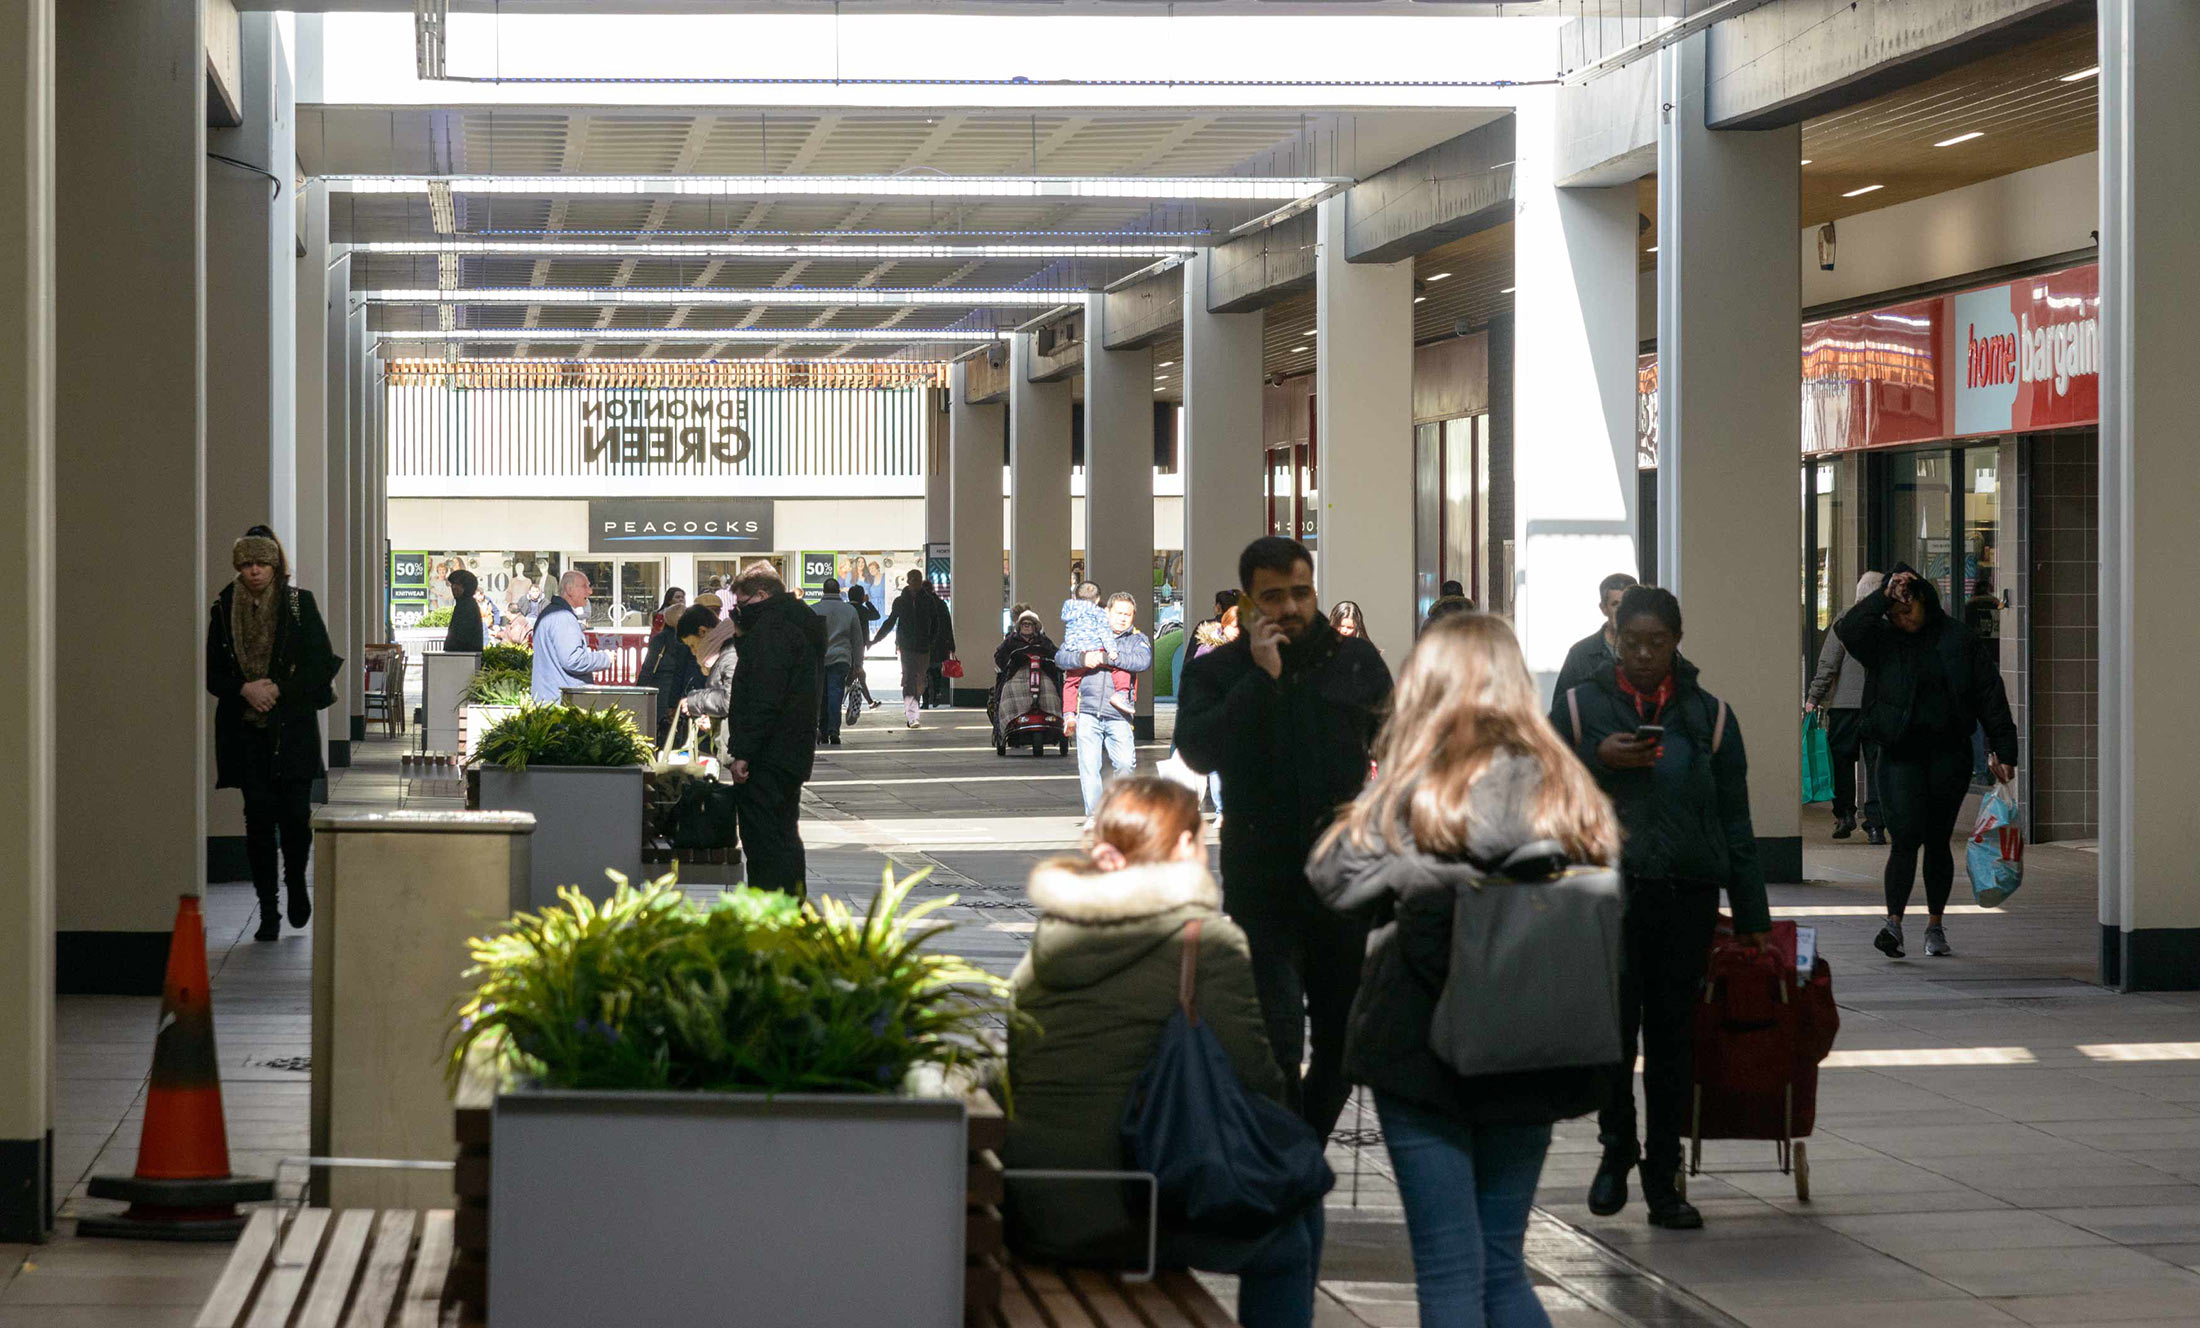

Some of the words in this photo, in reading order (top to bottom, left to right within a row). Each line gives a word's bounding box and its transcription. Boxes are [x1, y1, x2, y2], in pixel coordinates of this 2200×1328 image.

[1966, 322, 2017, 389] home
[2021, 301, 2100, 397] bargain
[604, 521, 759, 533] PEACOCKS
[396, 562, 424, 576] 50%
[805, 561, 833, 576] 50%
[394, 590, 425, 598] KNITWEAR
[804, 590, 825, 598] KNITW
